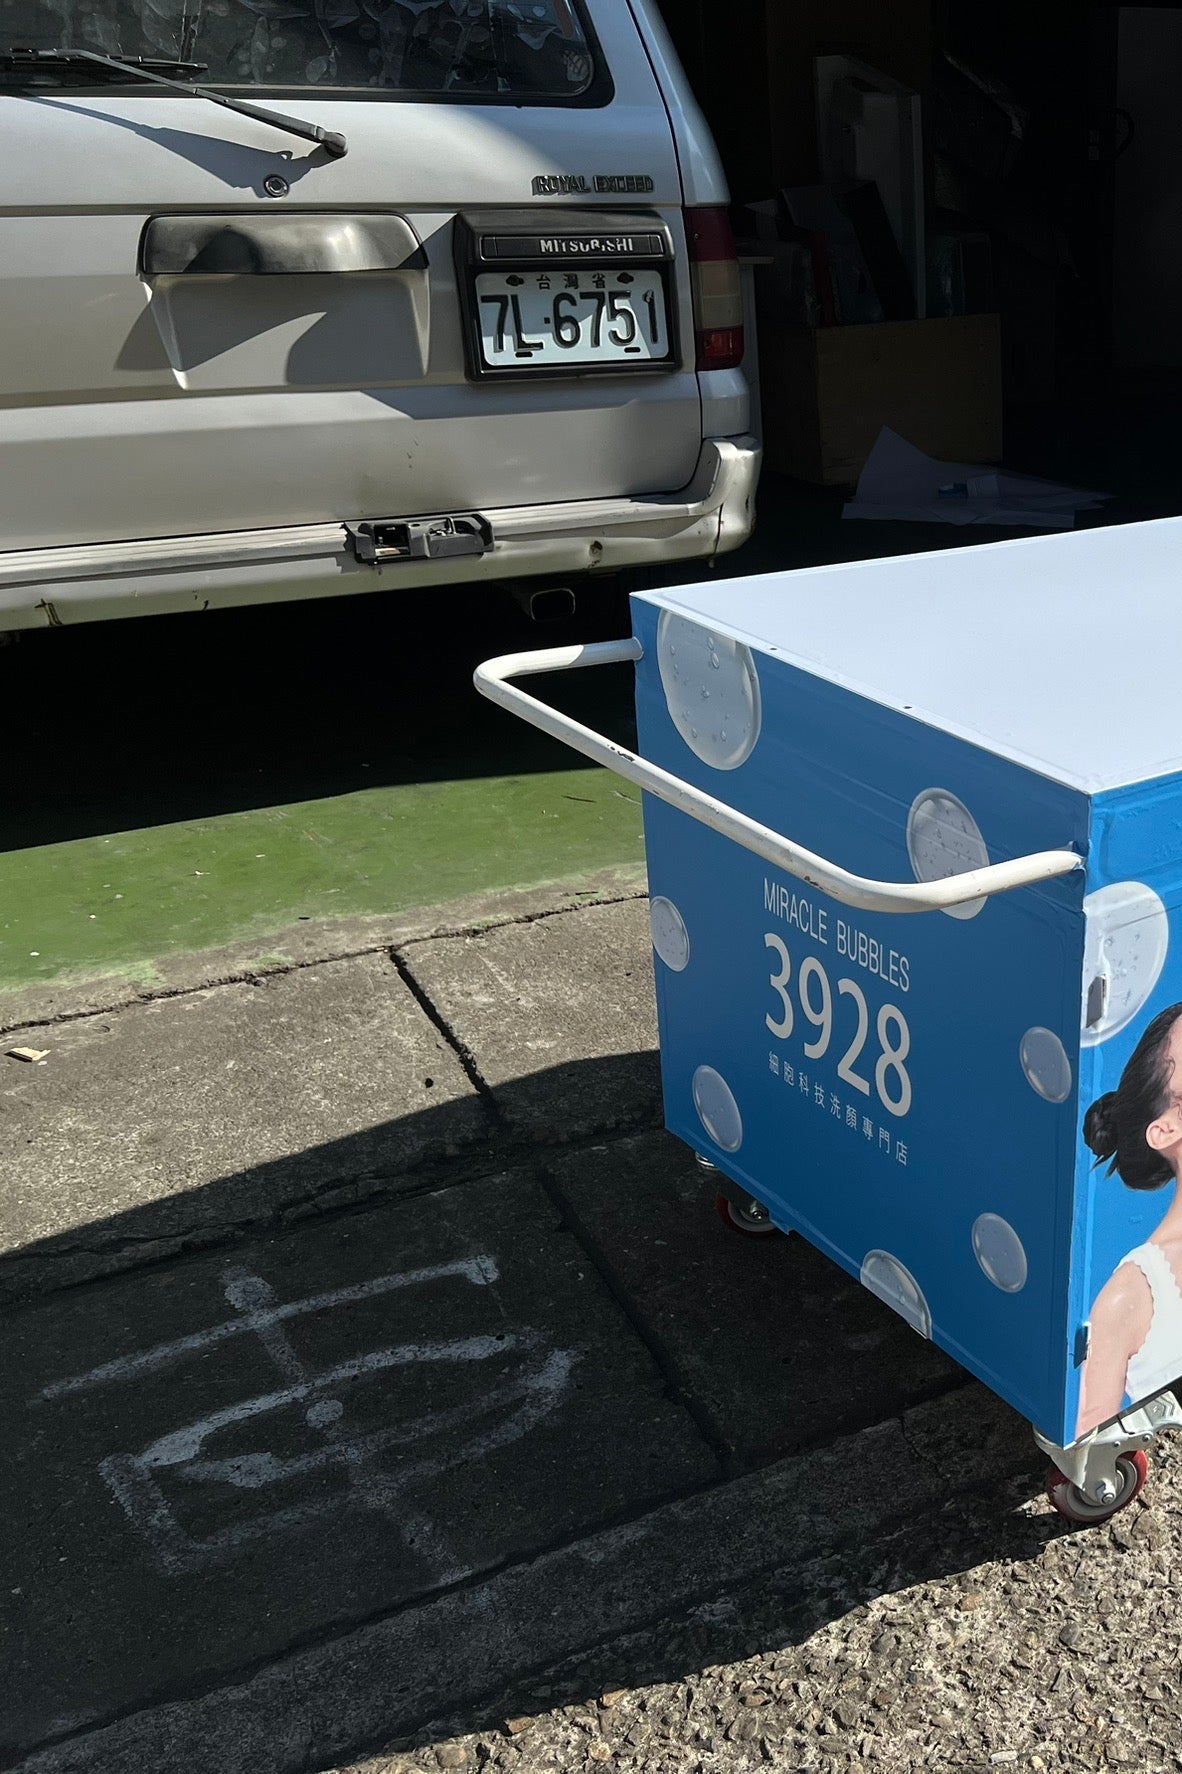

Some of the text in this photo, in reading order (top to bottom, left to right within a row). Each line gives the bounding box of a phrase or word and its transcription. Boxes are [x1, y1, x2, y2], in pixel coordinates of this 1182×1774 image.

[534, 174, 654, 194] ROYAL EXCEED
[536, 272, 607, 290] 台灣省
[764, 877, 910, 992] MIRACLE BUBBLES
[764, 932, 912, 1117] 3928
